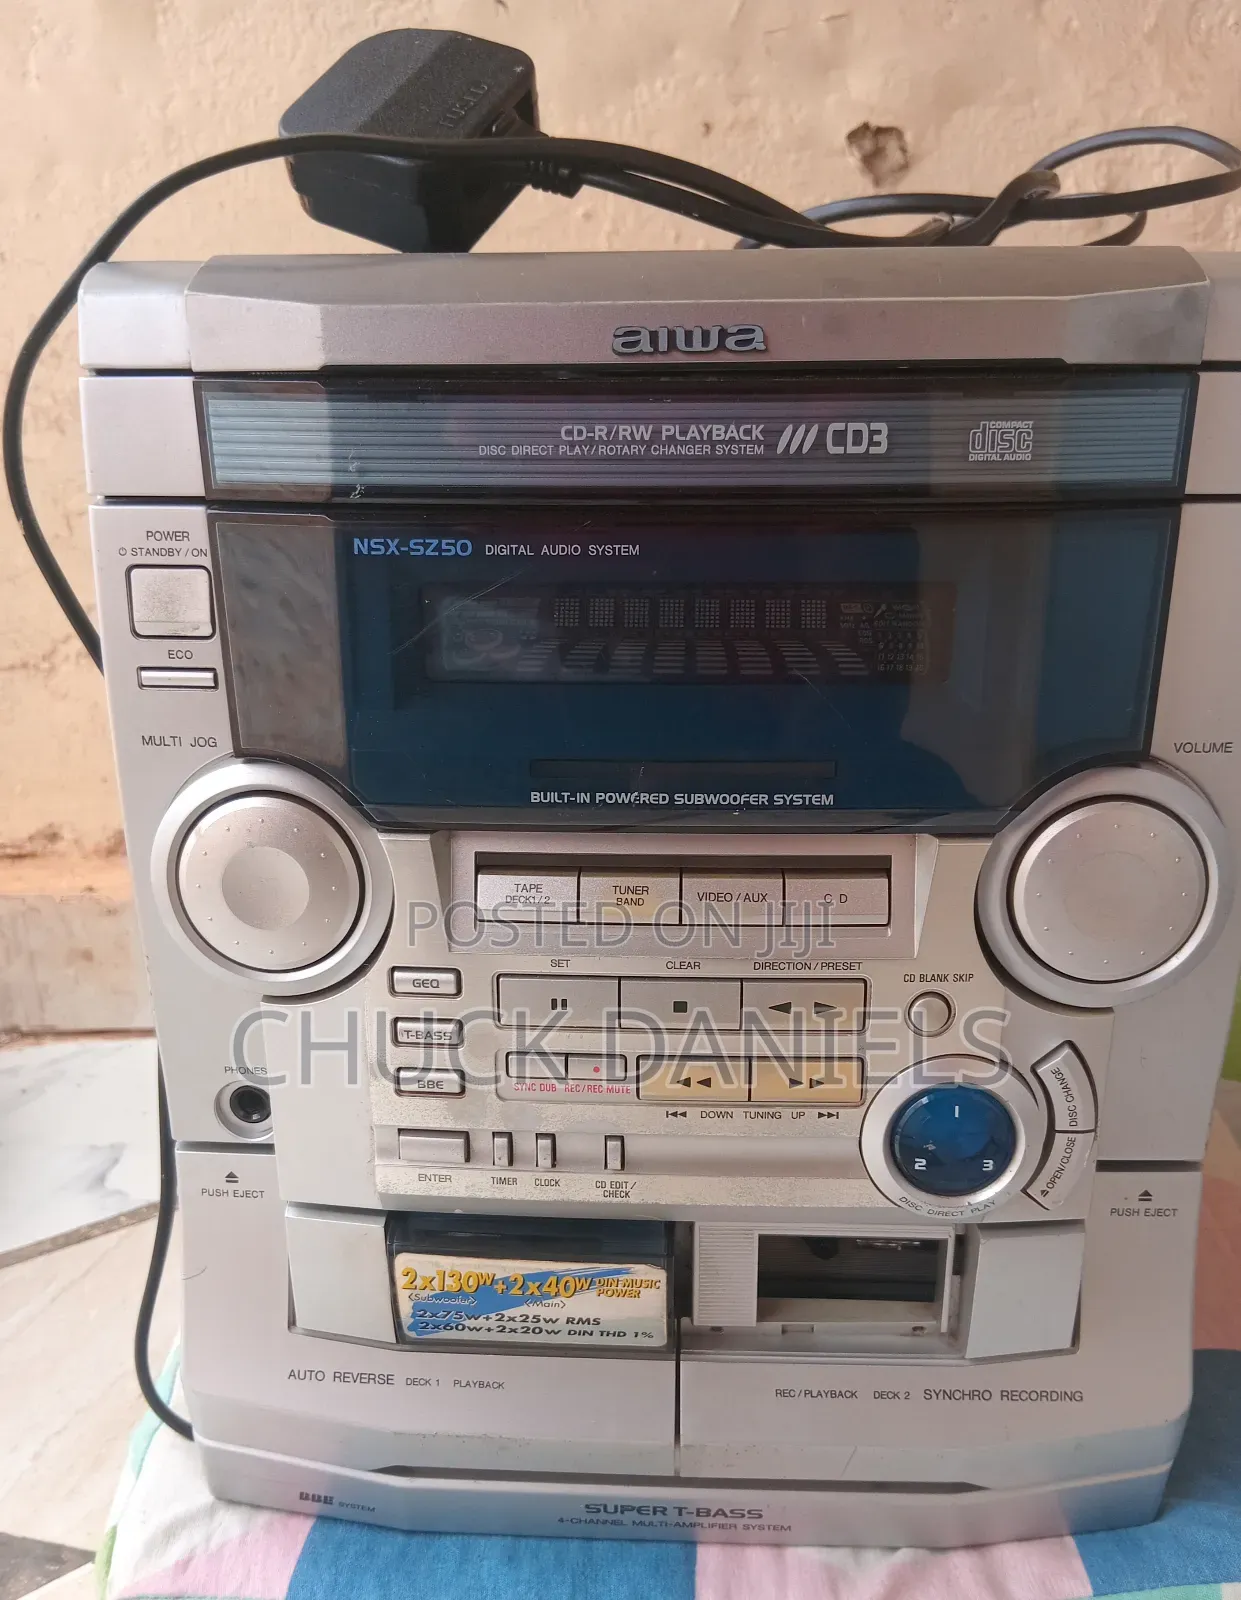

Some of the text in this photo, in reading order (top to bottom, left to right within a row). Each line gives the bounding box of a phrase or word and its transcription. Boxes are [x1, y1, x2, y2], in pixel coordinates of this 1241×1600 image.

[612, 324, 767, 355] aiwa
[989, 421, 1034, 429] COMPACT
[561, 424, 764, 441] CD-R/RW PLAYBACK
[826, 422, 888, 454] CD3
[969, 421, 1033, 453] disc
[479, 444, 764, 456] DISC DIRECT PLAY/ROTARY CHANGER SYSTEM
[968, 453, 1032, 461] DIGITAL AUDIO
[146, 531, 190, 542] POWER
[353, 537, 640, 556] NSX-SZ50 DIGITAL AUDIO SYSTEM
[168, 650, 193, 660] ECO
[142, 736, 217, 748] MULTI JOG
[1174, 742, 1233, 753] VOLUME
[530, 791, 834, 806] BUILT-IN POWERED SUBWOOFER SYSTEM
[514, 883, 543, 894] TAPE
[612, 885, 650, 896] TUNER
[616, 897, 645, 907] BAND
[550, 959, 571, 968] SET
[665, 961, 701, 971] CLEAR
[903, 973, 974, 983] CD BLANK SKIP
[412, 979, 440, 989] GEQ
[403, 1029, 453, 1041] T-BASS
[224, 1066, 268, 1075] PHONES
[417, 1079, 444, 1090] BBE
[514, 1083, 557, 1092] SYNC DUB
[564, 1084, 631, 1094] REC/REC MUTE
[1051, 1067, 1079, 1127] DISC CHANGE
[700, 1111, 806, 1121] DOWN TUNING UP
[954, 1105, 959, 1119] 1
[914, 1157, 927, 1171] 2
[982, 1158, 994, 1171] 3
[1046, 1136, 1077, 1189] OPEN/CLOSE
[418, 1173, 452, 1183] ENTER
[491, 1176, 518, 1186] TIMER
[534, 1178, 561, 1187] CLOCK
[595, 1180, 607, 1189] CD
[201, 1188, 265, 1199] PUSH EJECT
[603, 1190, 631, 1199] CHECK
[899, 1196, 996, 1218] DISC DIRECT PLAY
[1110, 1207, 1179, 1217] PUSH EJECT
[596, 1288, 641, 1298] POWER
[565, 1316, 602, 1326] RMS
[567, 1328, 594, 1337] DIN
[599, 1329, 628, 1338] THD
[633, 1331, 655, 1339] 1%
[287, 1369, 395, 1385] AUTO REVERSE
[405, 1377, 505, 1390] DECK 1 PLAYBACK
[873, 1390, 900, 1400] DECK
[903, 1391, 911, 1400] 2
[923, 1388, 1084, 1403] SYNCHRO RECORDING
[338, 1501, 376, 1512] SYSTEM
[585, 1503, 764, 1520] SUPER T-BASS
[557, 1517, 792, 1532] 4-CHANNEL MULTI-AMPLIFIER SYSTEM
